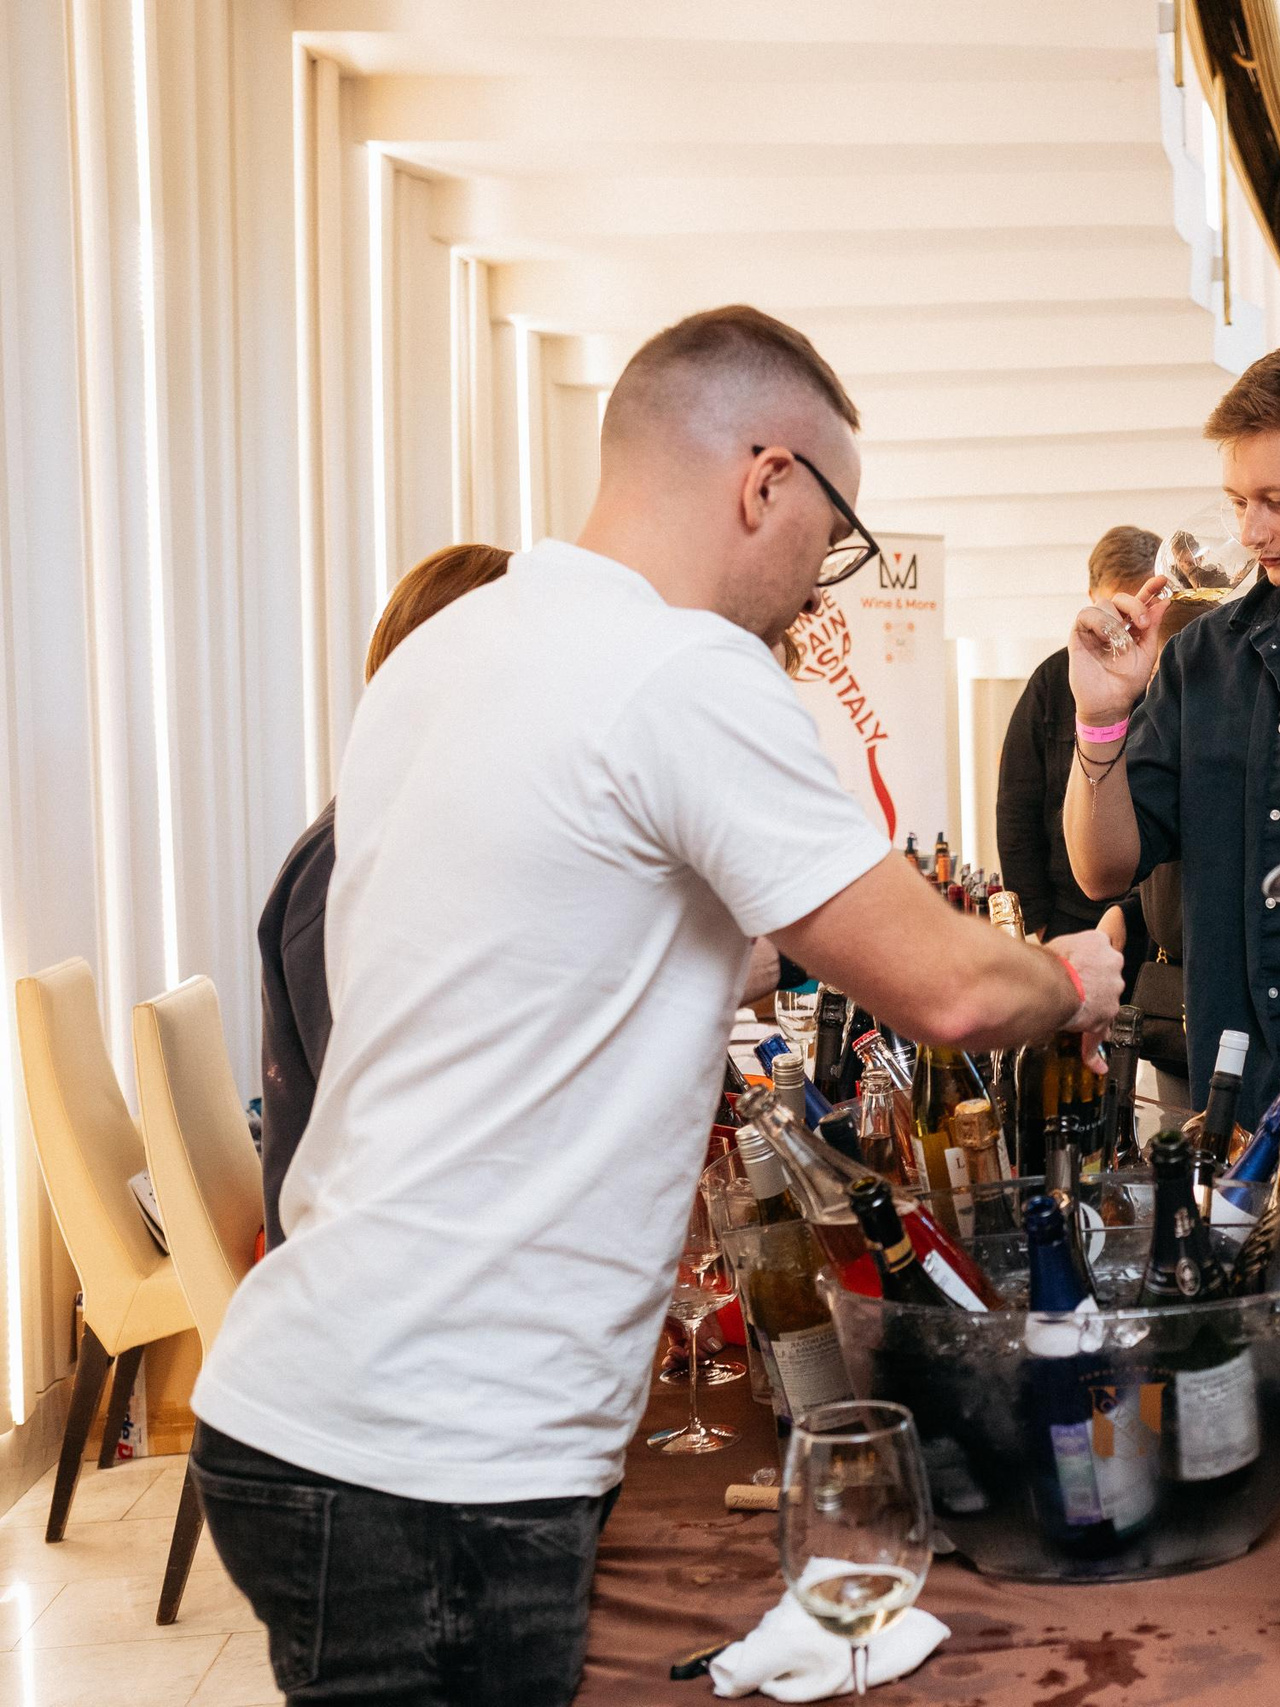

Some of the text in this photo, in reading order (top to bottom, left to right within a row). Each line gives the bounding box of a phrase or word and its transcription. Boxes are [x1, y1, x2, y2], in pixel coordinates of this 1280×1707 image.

[861, 597, 893, 609] Wine
[906, 598, 937, 611] More
[829, 665, 889, 743] ITALY
